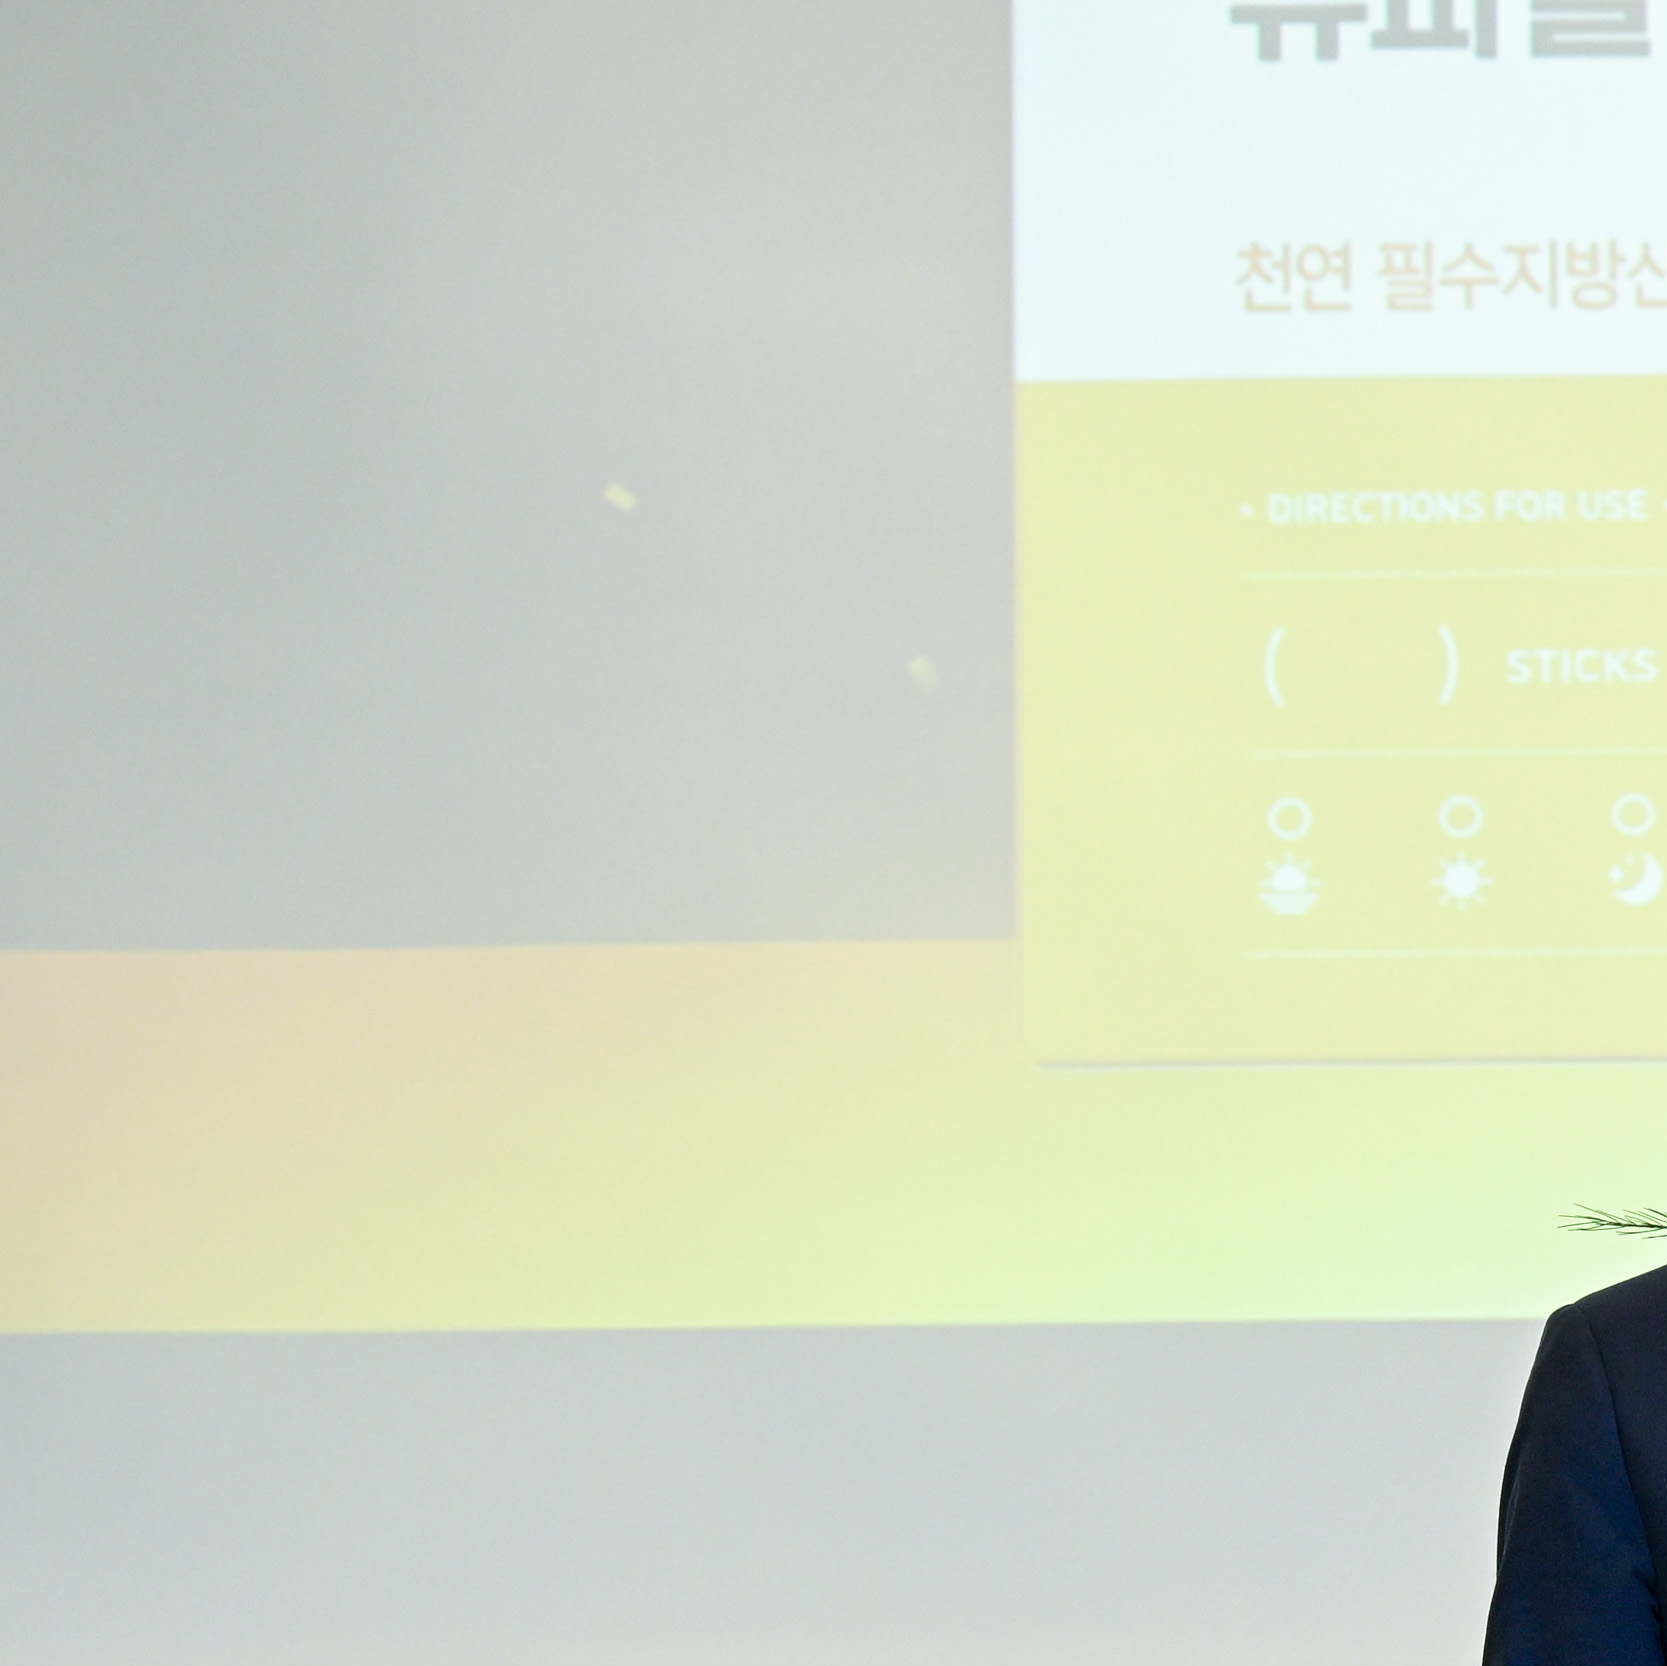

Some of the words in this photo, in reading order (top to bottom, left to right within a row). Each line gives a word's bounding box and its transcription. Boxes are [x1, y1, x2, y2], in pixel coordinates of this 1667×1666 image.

[1234, 238, 1354, 314] 천연
[1267, 491, 1484, 525] DIRECTIONS
[1496, 490, 1567, 522] FOR
[1576, 488, 1648, 521] USE
[1506, 648, 1659, 685] STICKS
